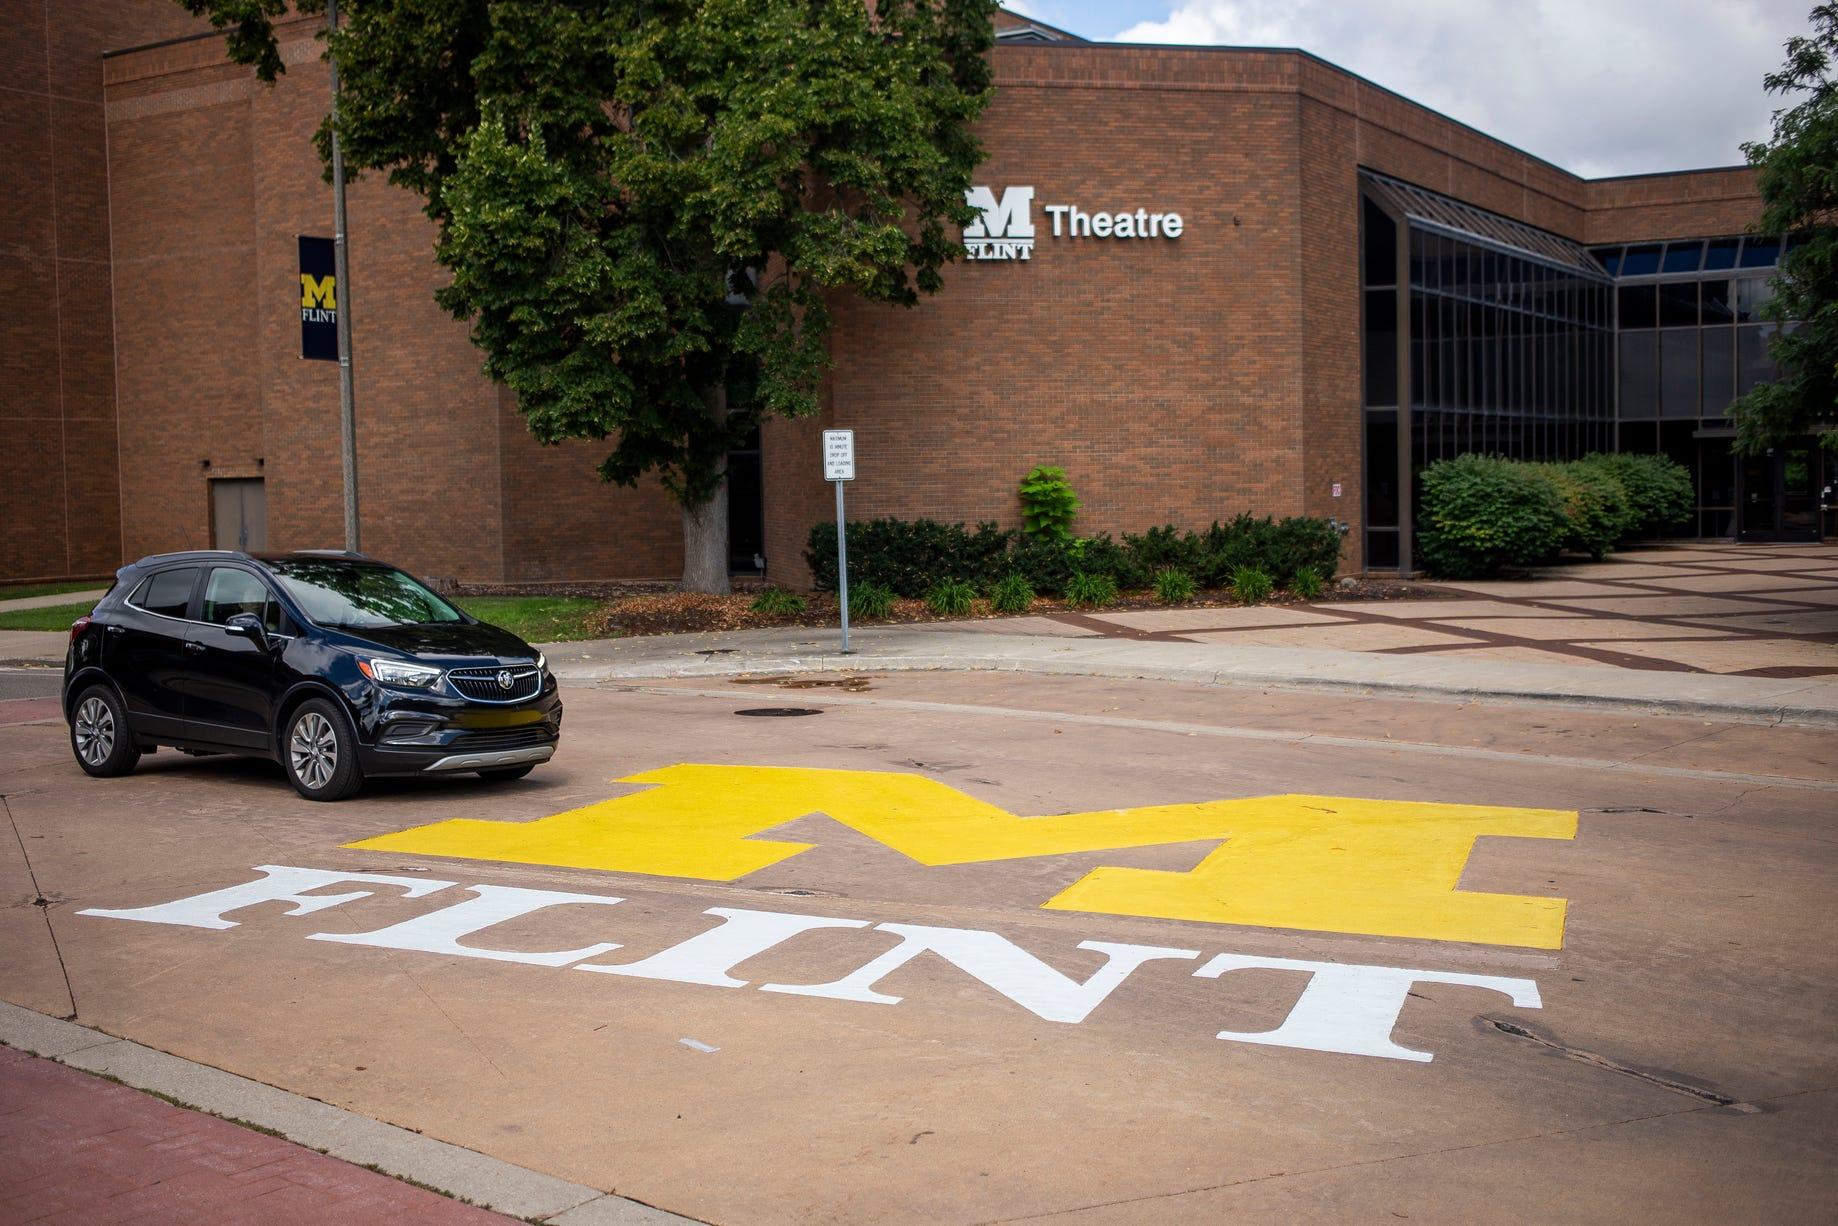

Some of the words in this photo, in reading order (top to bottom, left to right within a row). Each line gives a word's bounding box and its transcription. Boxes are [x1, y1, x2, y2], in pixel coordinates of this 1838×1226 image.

[963, 186, 1035, 237] M
[1045, 205, 1184, 238] Theatre
[964, 243, 1034, 260] FLINT
[301, 273, 336, 309] M
[302, 308, 337, 324] FLINT
[342, 762, 1579, 949] M
[74, 863, 1544, 1063] FLINT
